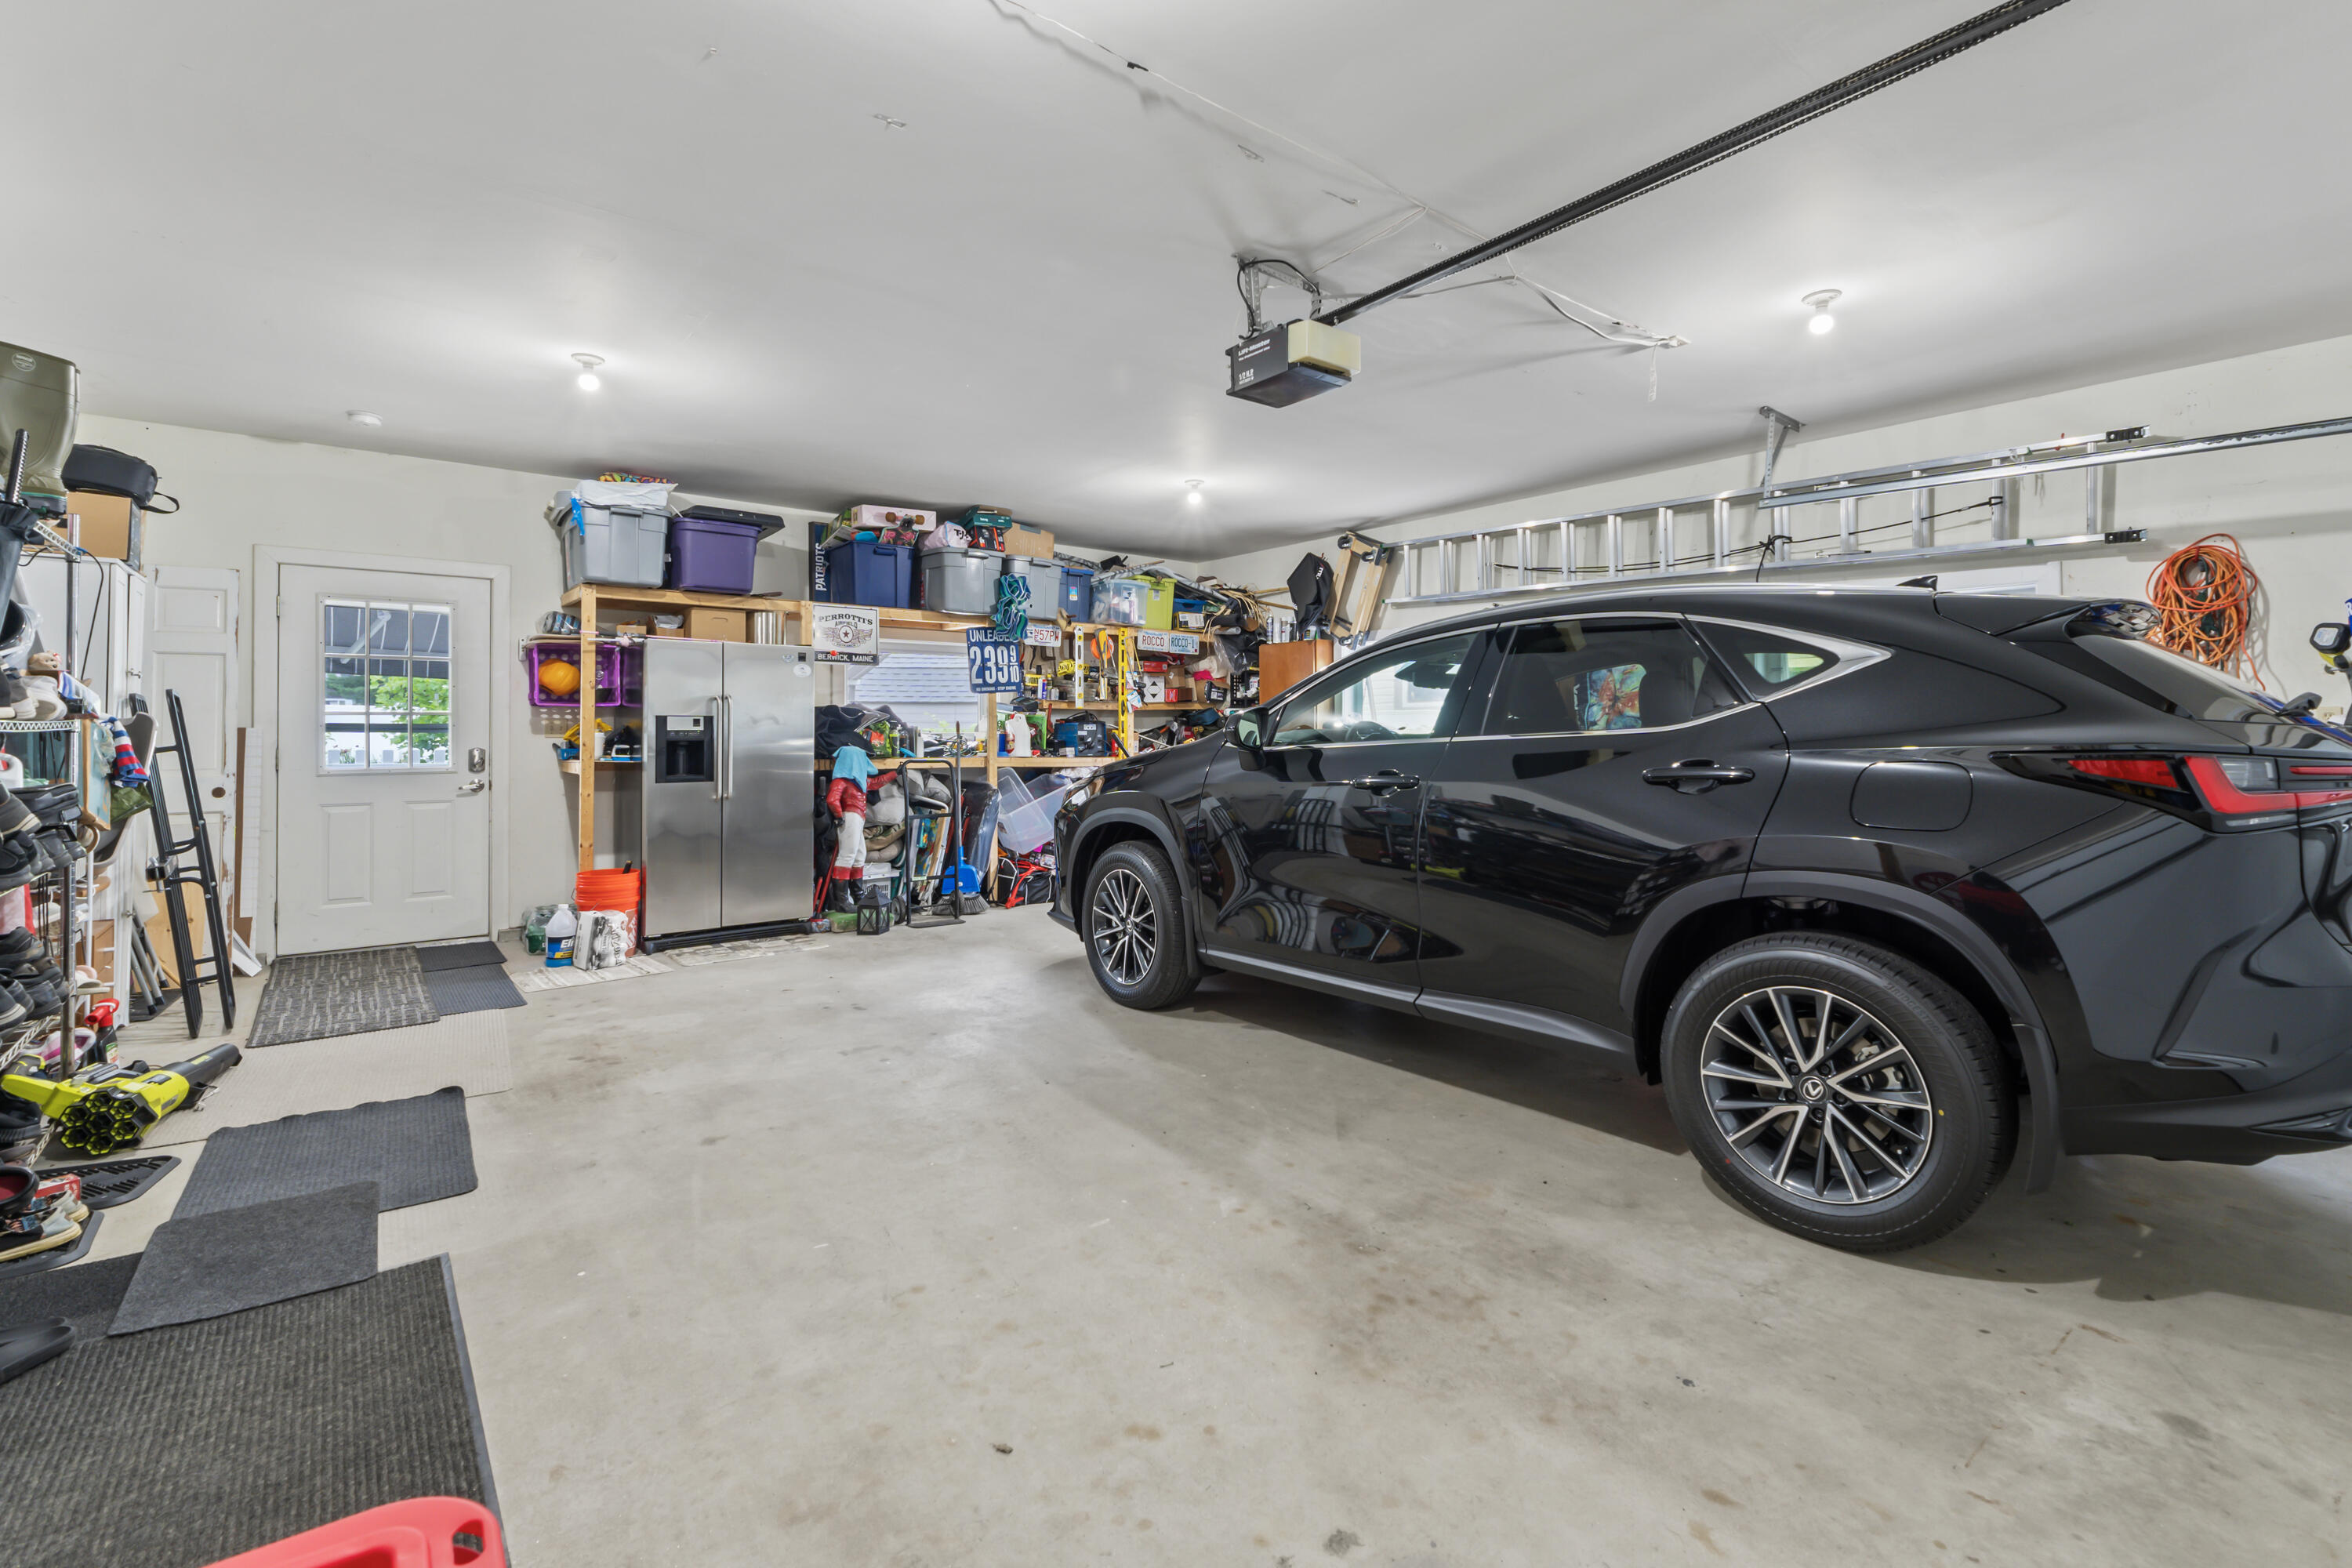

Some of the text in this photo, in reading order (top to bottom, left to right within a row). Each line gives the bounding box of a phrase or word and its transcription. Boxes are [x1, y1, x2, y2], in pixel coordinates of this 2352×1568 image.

[815, 543, 827, 591] PATRIOTS
[1142, 635, 1165, 647] ROCCO
[1171, 637, 1195, 648] ROCCO-1
